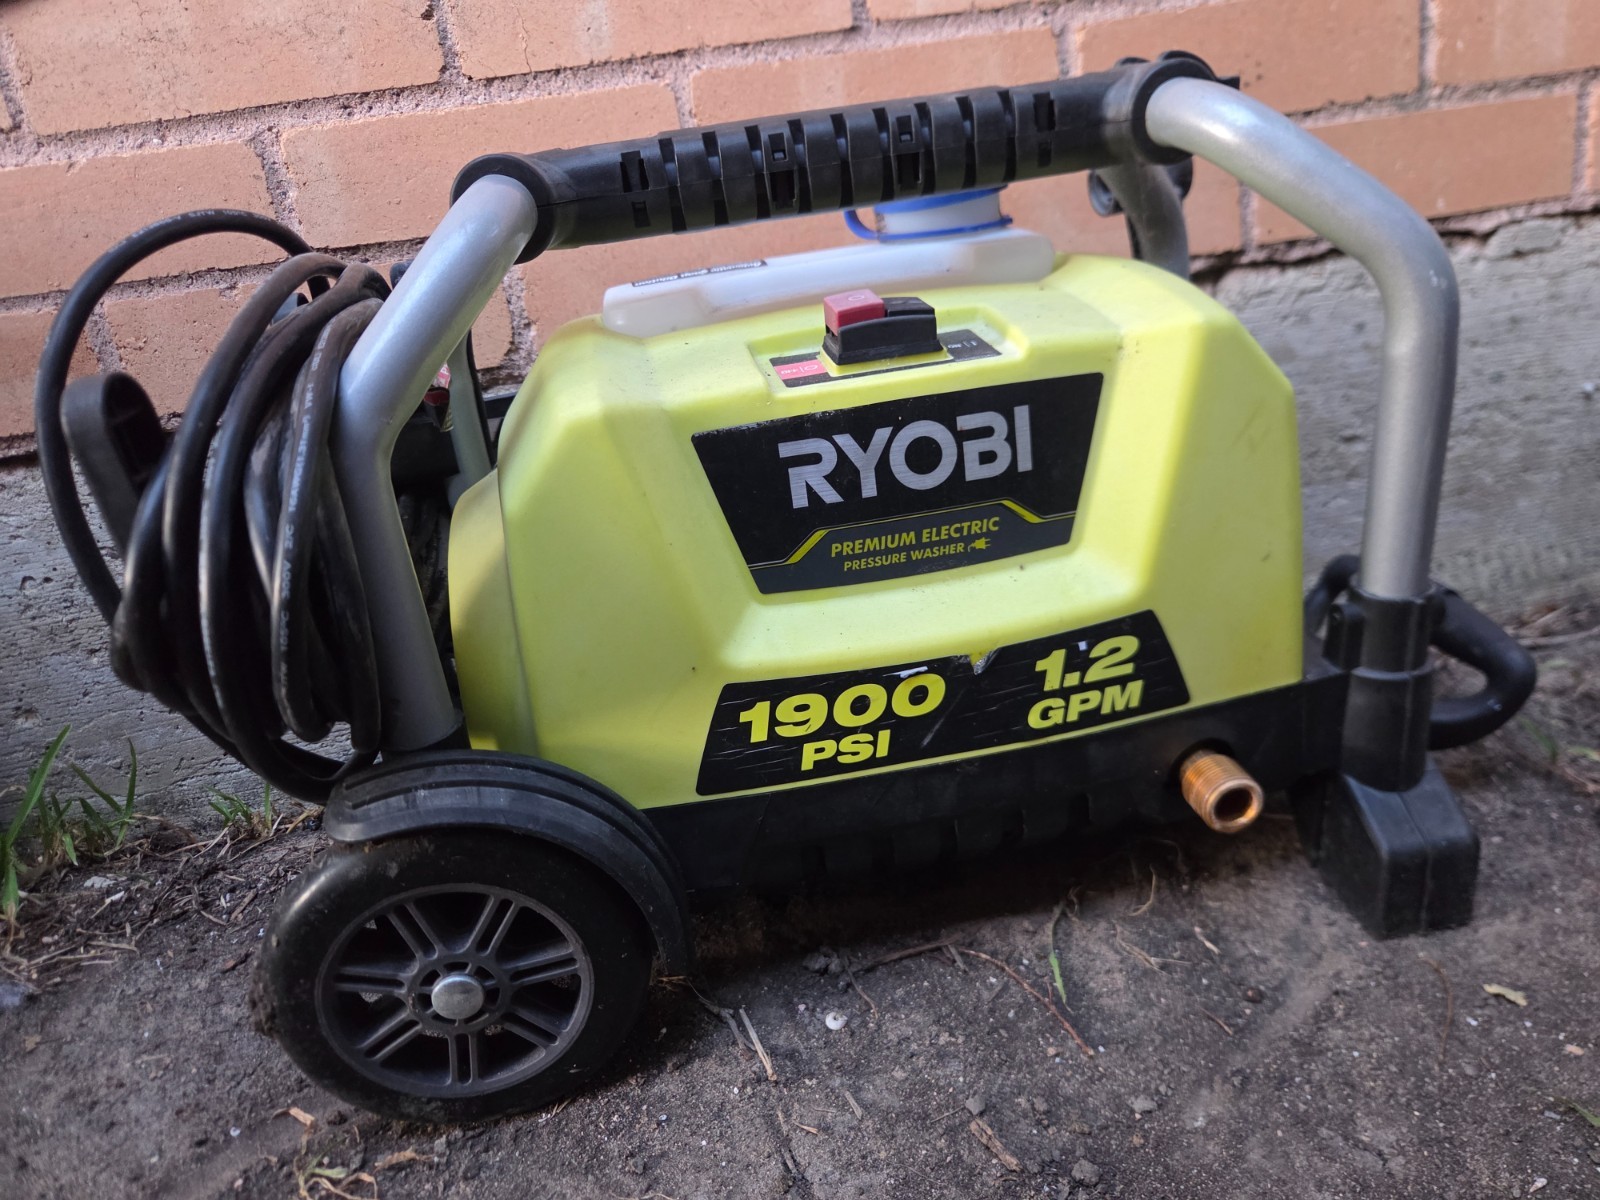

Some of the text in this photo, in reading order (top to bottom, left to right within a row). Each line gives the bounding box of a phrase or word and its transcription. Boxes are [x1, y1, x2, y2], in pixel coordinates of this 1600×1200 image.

[778, 404, 1033, 509] RYOBI
[831, 516, 1000, 558] PREMIUM ELECTRIC
[843, 542, 965, 572] PRESSURE WASHER
[1035, 635, 1140, 692] 1.2
[739, 673, 946, 743] 1900
[1027, 680, 1143, 731] GPM
[801, 729, 891, 771] PSI
